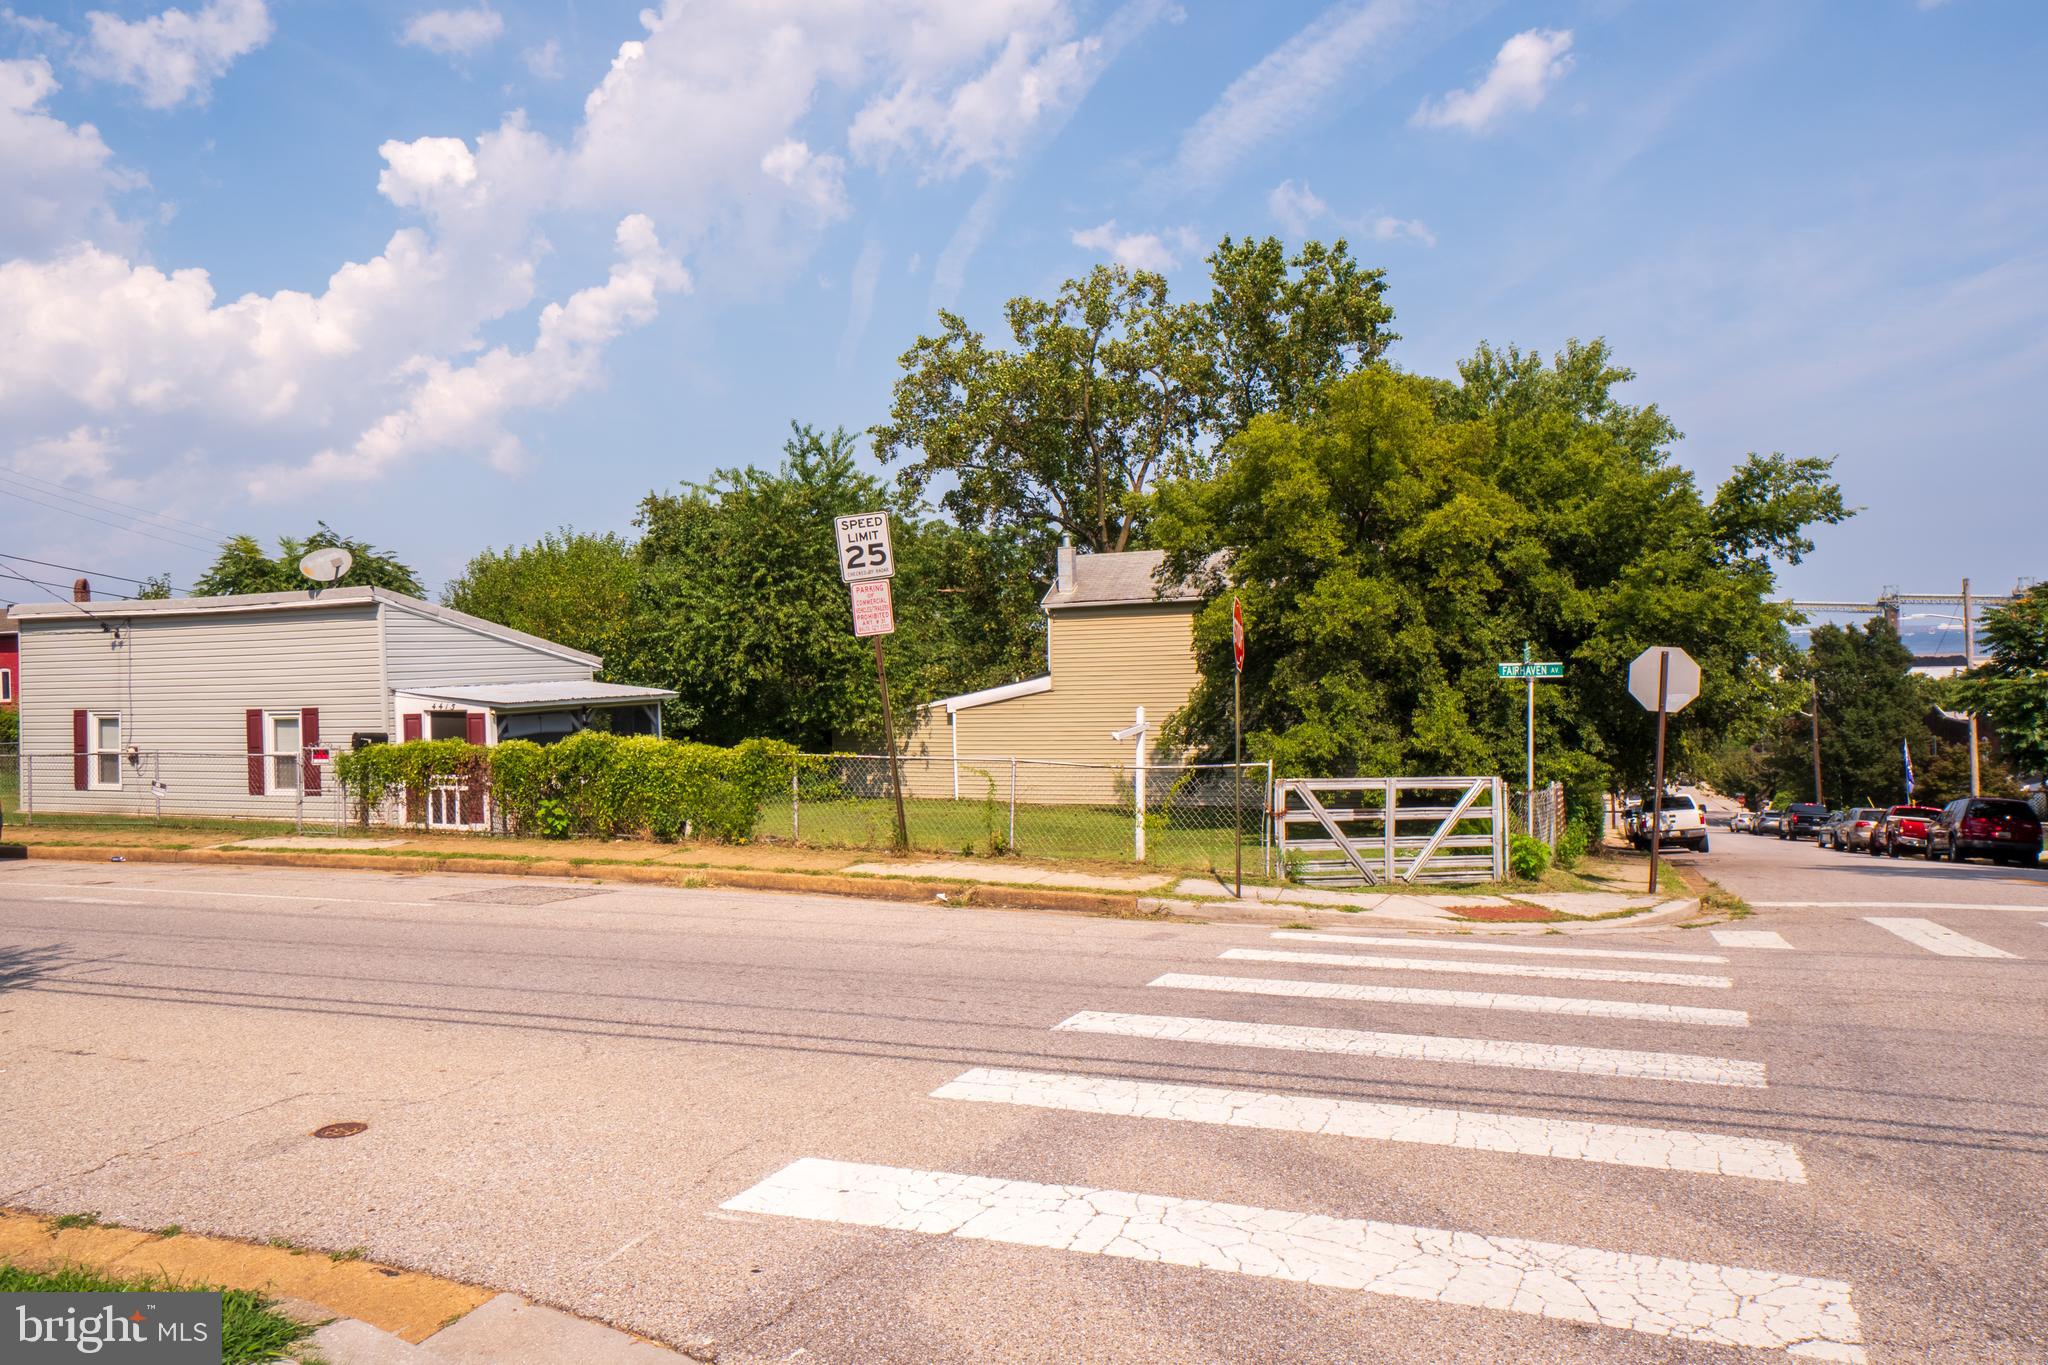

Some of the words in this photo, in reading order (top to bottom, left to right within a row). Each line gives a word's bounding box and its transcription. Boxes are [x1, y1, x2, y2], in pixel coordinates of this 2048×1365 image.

[841, 517, 883, 531] SPEED
[848, 530, 879, 543] LIMIT
[845, 543, 887, 569] 25
[855, 584, 884, 593] PARKING
[856, 597, 887, 606] COMMERCIAL
[857, 611, 890, 620] PROHIBITED
[1502, 665, 1547, 676] FAIRHAVEN
